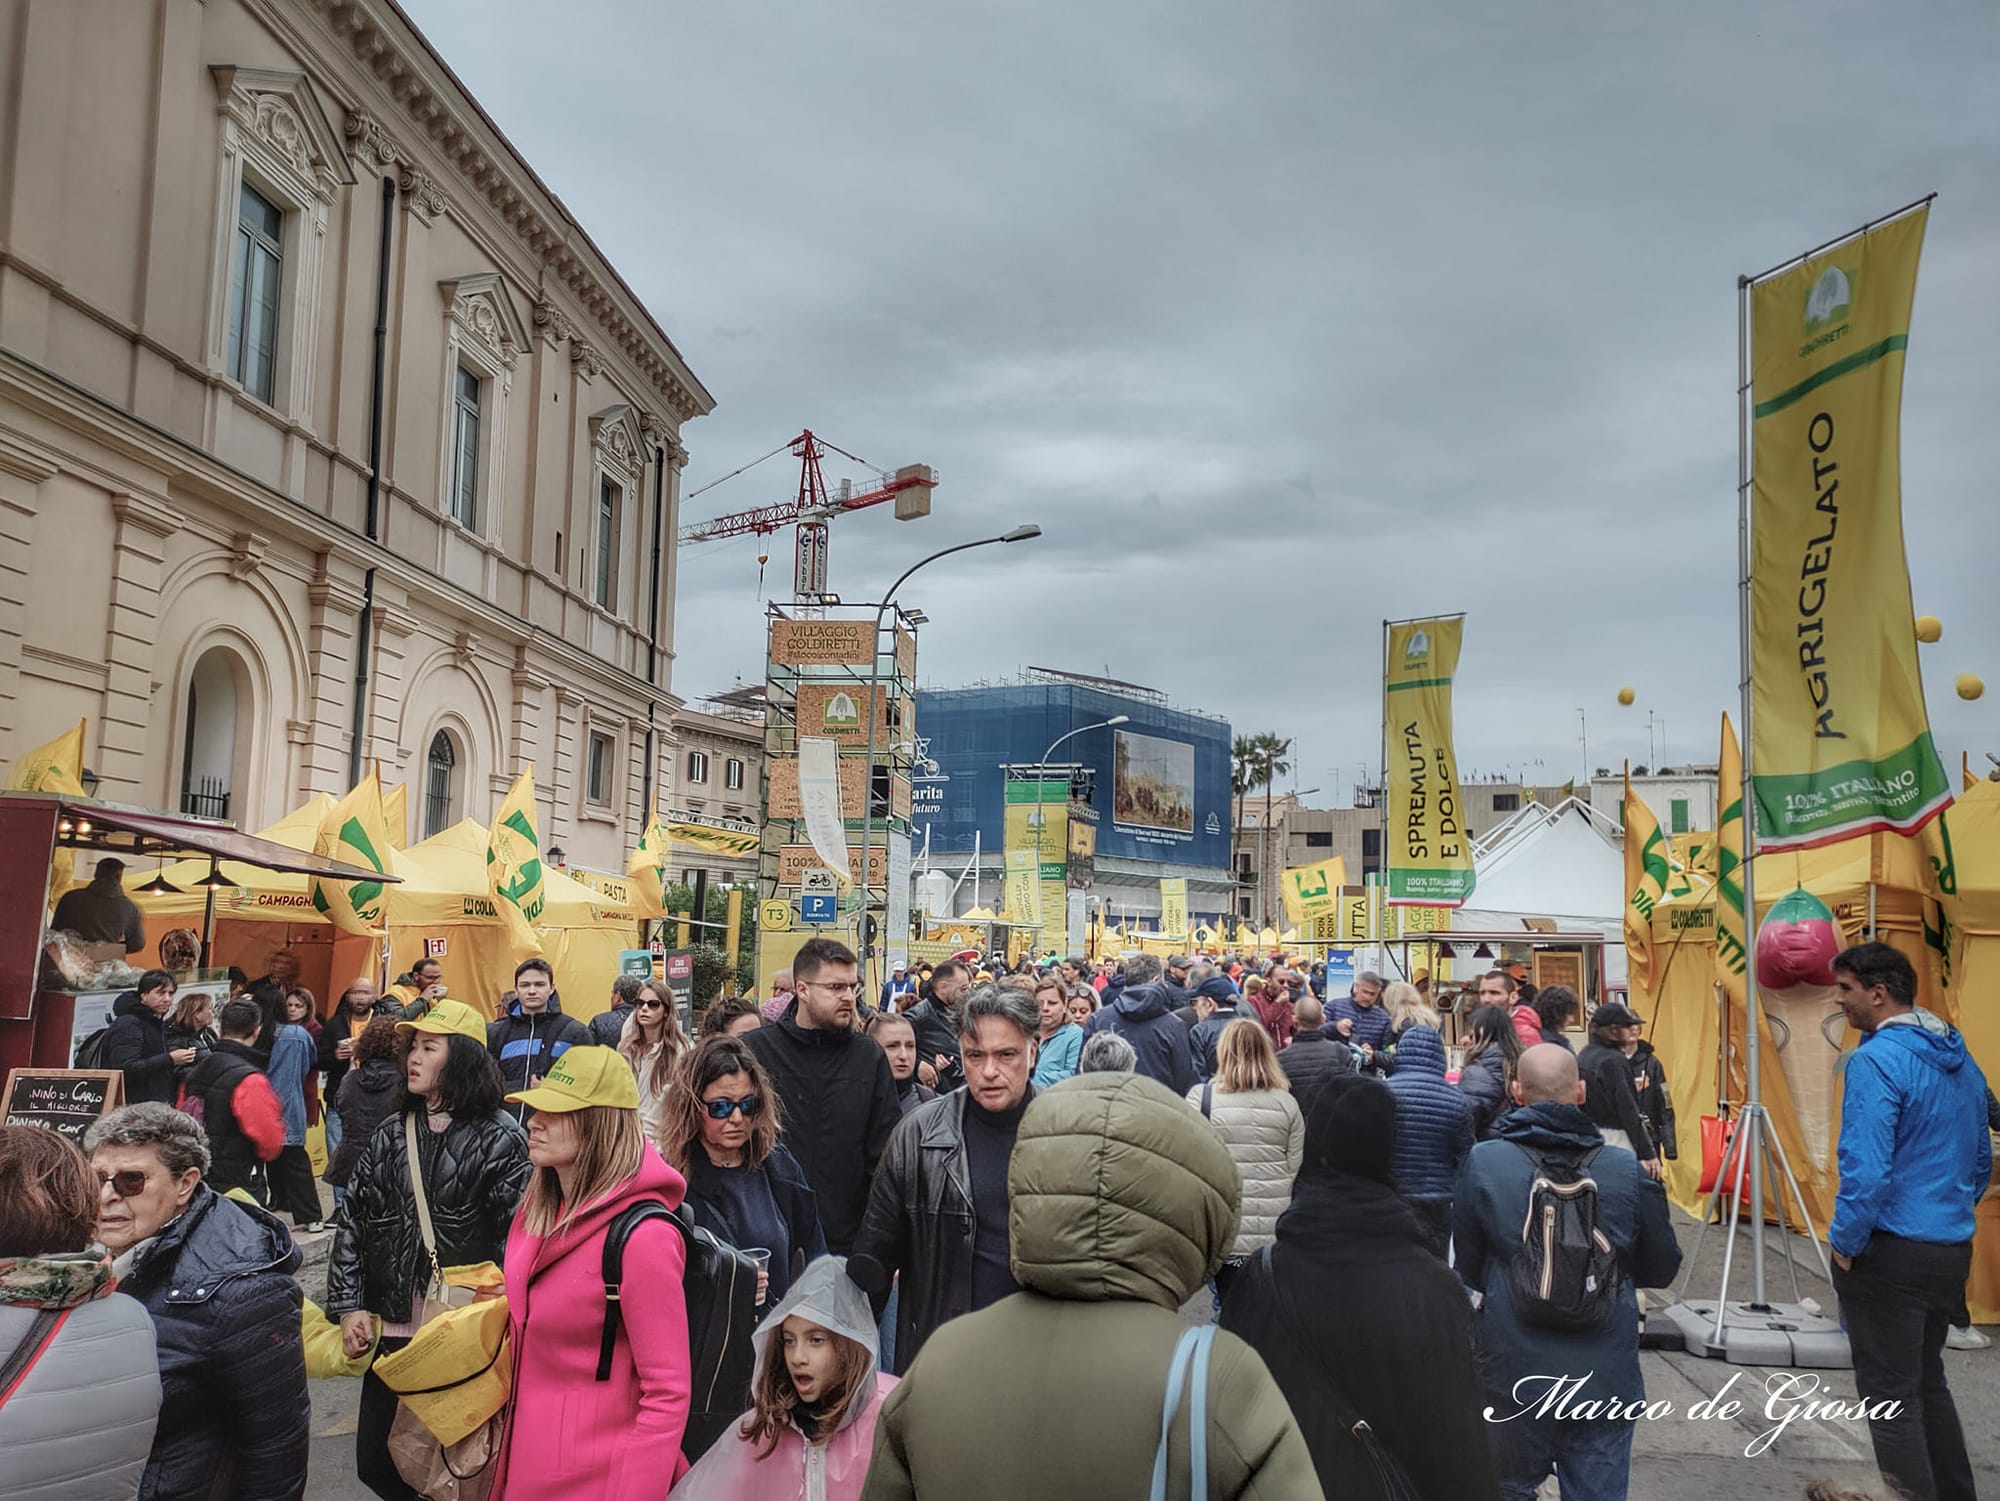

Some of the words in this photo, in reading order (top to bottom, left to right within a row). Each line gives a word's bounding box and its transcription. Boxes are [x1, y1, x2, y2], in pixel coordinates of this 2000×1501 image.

[1797, 410, 1844, 742] AGRIGELATO
[791, 625, 858, 638] VILLAGGIO
[787, 638, 860, 650] COLDIRETTI
[1404, 721, 1428, 860] SPREMUTA
[1434, 747, 1458, 838] DOLCE
[1441, 843, 1459, 860] E
[787, 857, 817, 868] 100%
[814, 898, 825, 912] P
[766, 909, 784, 921] T3
